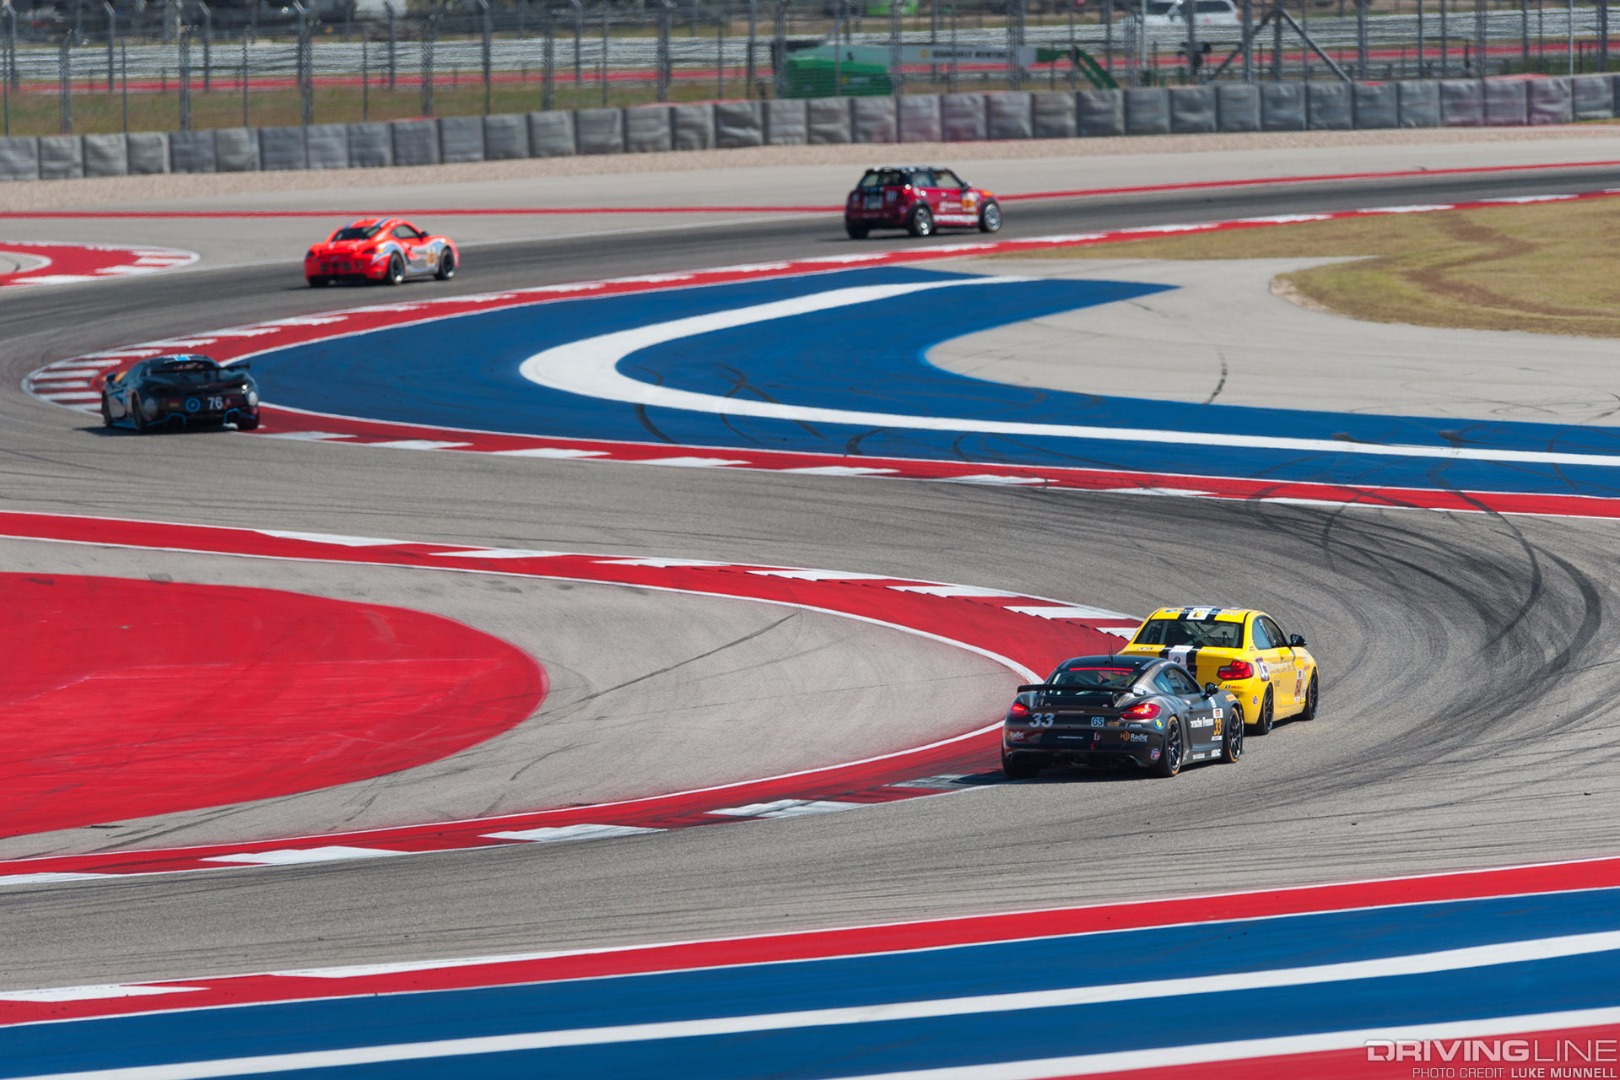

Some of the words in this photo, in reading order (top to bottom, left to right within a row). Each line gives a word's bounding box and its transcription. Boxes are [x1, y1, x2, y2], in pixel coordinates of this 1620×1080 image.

[208, 396, 223, 410] 76
[1029, 712, 1055, 728] 33
[1092, 717, 1104, 727] GS
[1213, 718, 1222, 736] 33
